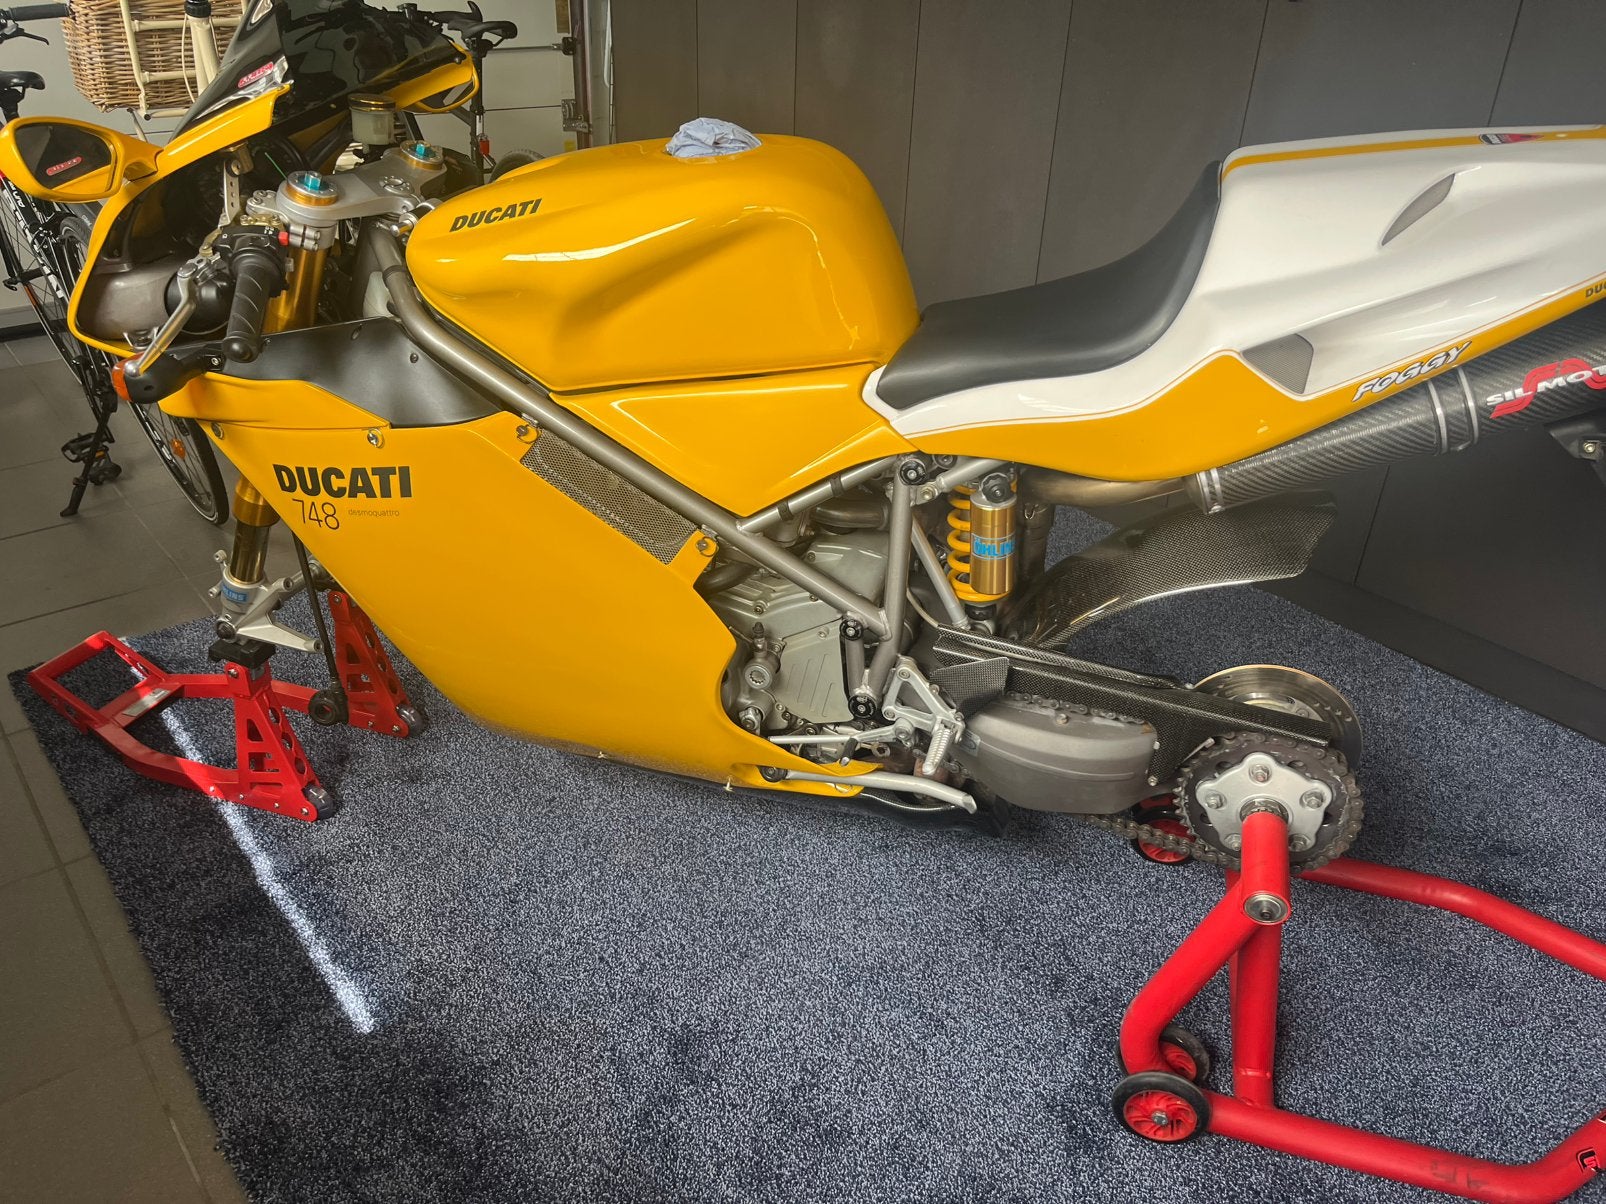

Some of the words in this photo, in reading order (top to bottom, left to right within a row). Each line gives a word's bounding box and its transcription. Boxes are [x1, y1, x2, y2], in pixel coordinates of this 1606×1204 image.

[449, 198, 542, 232] DUCATI
[1352, 341, 1473, 402] FOGGY
[272, 464, 412, 498] DUCATI
[292, 498, 340, 530] 748
[348, 508, 400, 518] desmoquattro
